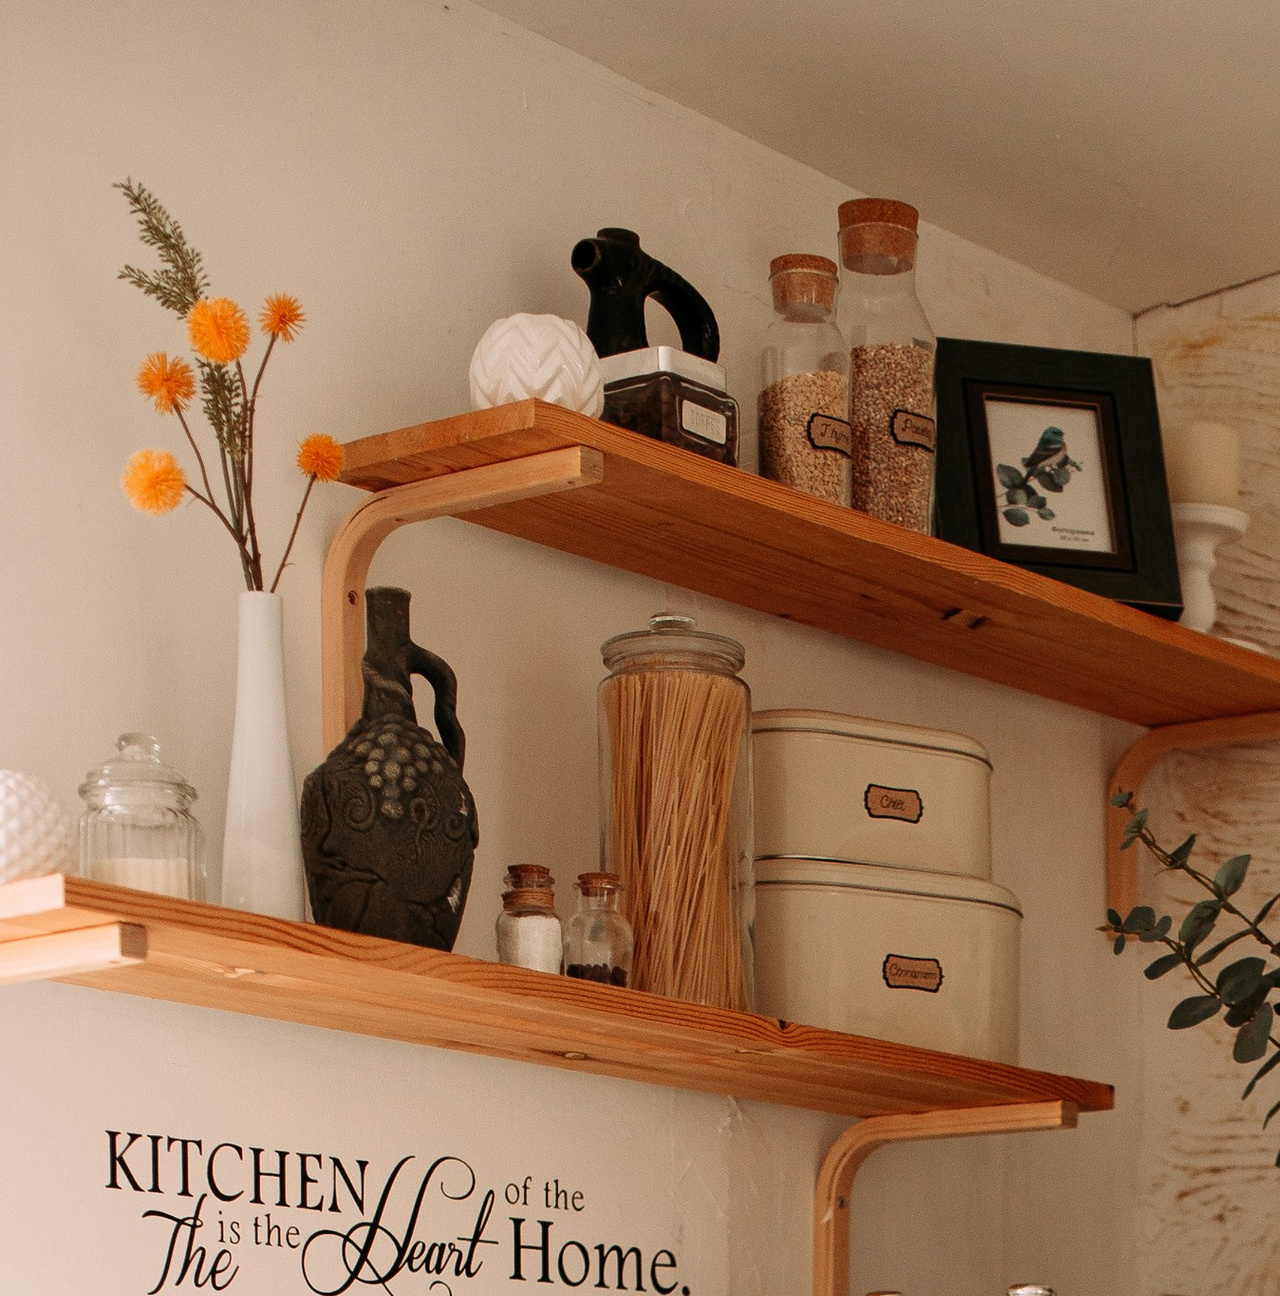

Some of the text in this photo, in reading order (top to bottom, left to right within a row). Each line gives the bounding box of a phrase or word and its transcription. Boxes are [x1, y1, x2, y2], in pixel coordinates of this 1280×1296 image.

[105, 1130, 370, 1216] KITCHEN
[504, 1175, 586, 1213] of the
[142, 1193, 240, 1296] The
[217, 1210, 242, 1245] is
[253, 1213, 301, 1250] the
